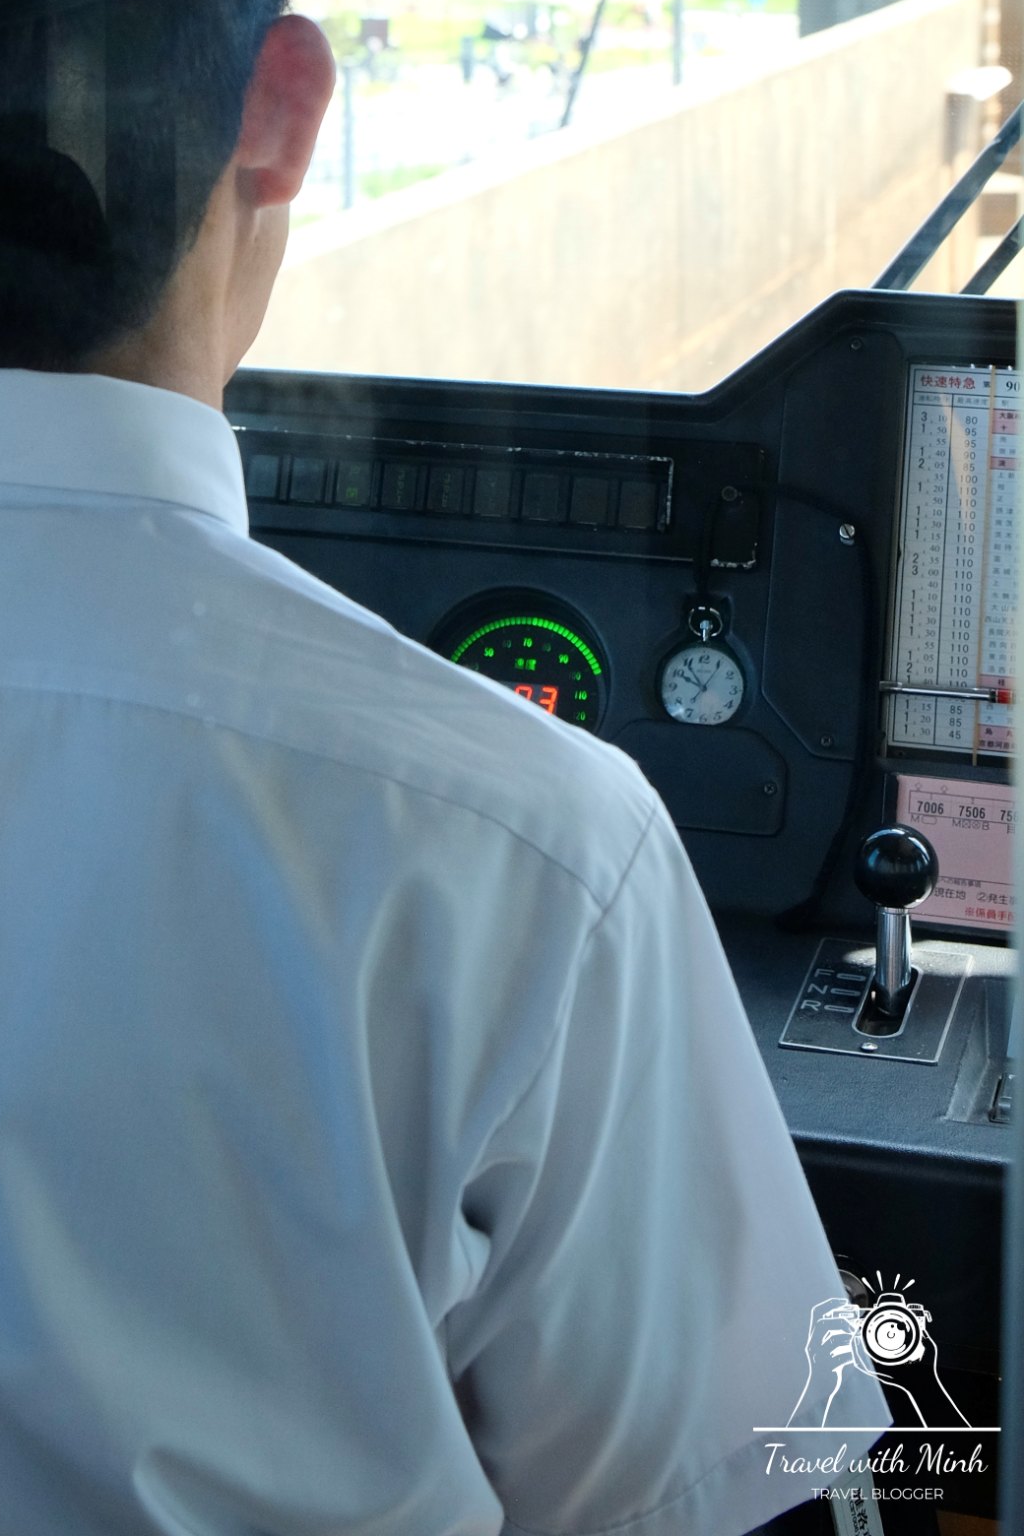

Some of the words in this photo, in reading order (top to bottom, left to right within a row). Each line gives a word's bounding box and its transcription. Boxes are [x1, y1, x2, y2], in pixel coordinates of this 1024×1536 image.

[921, 375, 976, 389] 快速特急
[965, 416, 978, 425] 80
[964, 428, 977, 437] 95
[958, 511, 976, 519] 110
[957, 522, 975, 531] 110
[957, 534, 974, 543] 110
[956, 546, 974, 555] 110
[955, 558, 973, 568] 110
[955, 570, 973, 580] 110
[954, 582, 972, 592] 110
[953, 594, 972, 604] 110
[953, 606, 971, 616] 110
[952, 619, 970, 628] 110
[951, 631, 970, 641] 110
[951, 643, 969, 653] 110
[483, 647, 495, 658] 50
[559, 653, 570, 664] 90
[698, 654, 711, 664] 12
[950, 655, 968, 665] 110
[725, 670, 735, 680] 2
[950, 668, 968, 678] 110
[668, 682, 678, 692] 9
[729, 685, 738, 696] 3
[574, 690, 587, 701] 110
[723, 699, 734, 709] 4
[684, 708, 694, 718] 7
[950, 705, 962, 715] 85
[699, 713, 708, 723] 6
[713, 711, 723, 721] 5
[949, 717, 962, 727] 85
[949, 729, 961, 739] 45
[917, 800, 945, 815] 7006
[958, 804, 986, 820] 7506
[814, 968, 835, 979] F
[807, 983, 828, 996] N
[800, 999, 821, 1012] R
